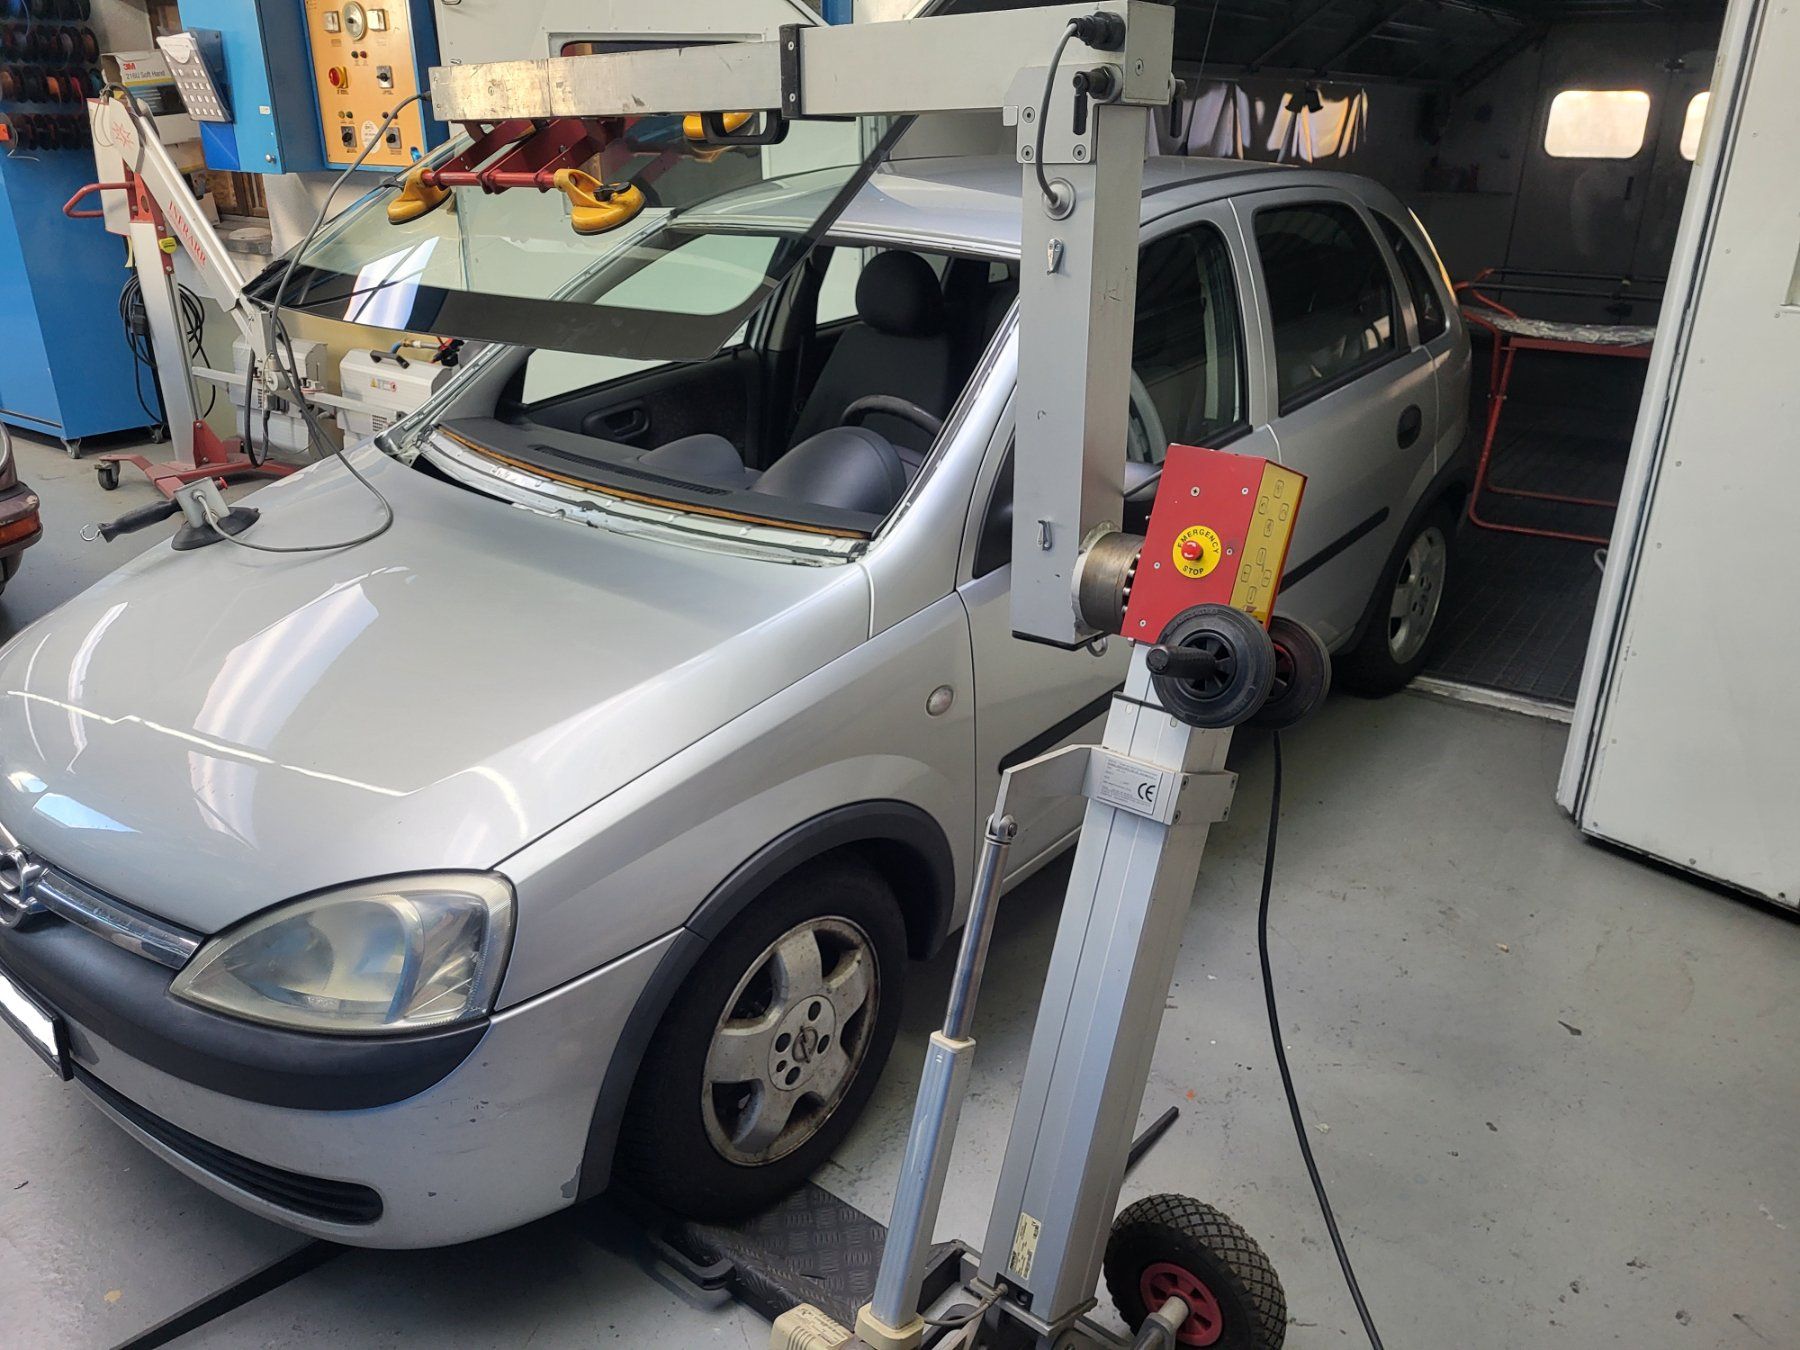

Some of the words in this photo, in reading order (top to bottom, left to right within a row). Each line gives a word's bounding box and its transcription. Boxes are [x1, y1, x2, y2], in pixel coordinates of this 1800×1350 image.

[123, 62, 136, 71] 3M
[1177, 529, 1219, 554] EMERGENCY
[1182, 565, 1204, 575] STOP
